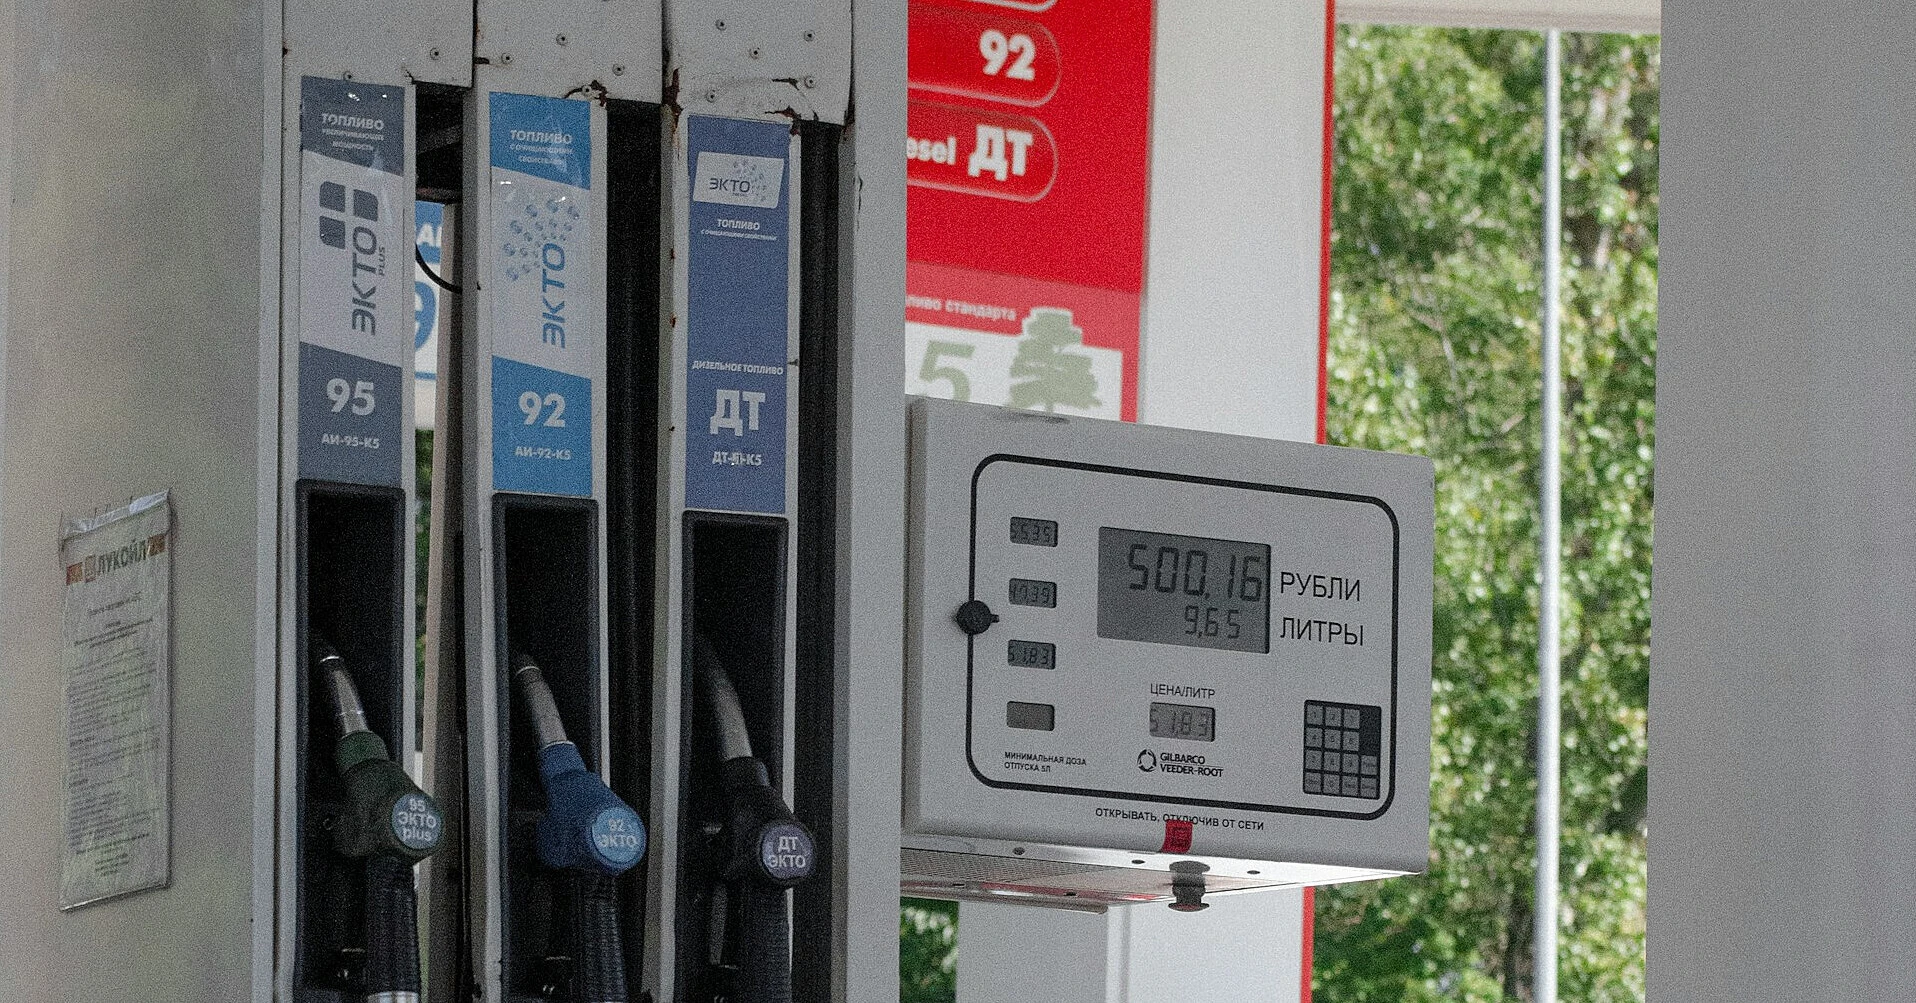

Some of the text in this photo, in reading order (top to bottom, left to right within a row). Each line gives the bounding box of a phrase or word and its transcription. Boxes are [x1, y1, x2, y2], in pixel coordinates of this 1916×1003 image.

[979, 29, 1036, 81] 92
[321, 113, 385, 131] ТОПЛИВО
[509, 129, 573, 145] ТОПЛИВО
[968, 124, 1035, 182] ДТ
[709, 177, 751, 193] ЭКТО
[717, 218, 760, 231] ТОПЛИВО
[378, 246, 386, 276] PLUS
[352, 226, 377, 336] ЭКТО
[542, 243, 566, 349] ЭКТО
[945, 299, 1018, 322] стандарта
[692, 360, 783, 376] ДИЗЕЛЬНОЕ ТОПЛИВО
[919, 340, 976, 403] 5
[326, 378, 376, 416] 95
[518, 391, 566, 429] 92
[710, 389, 766, 437] ДТ
[321, 432, 380, 450] АИ-95-К5
[515, 445, 572, 461] АИ-92-К5
[1127, 543, 1262, 602] 500,16
[1280, 571, 1361, 602] РУБЛИ
[1185, 605, 1240, 639] 9,65
[1280, 617, 1364, 646] ЛИТРЫ
[1150, 683, 1216, 700] ЦЕНА/ЛИТР
[1004, 751, 1087, 766] МИНИМАЛЬНАЯ ДОЗА
[1004, 761, 1039, 772] ОТПУСКА
[1160, 752, 1206, 765] GILBARCO
[1160, 764, 1224, 778] VEEDER-ROOT
[409, 798, 426, 813] 95
[398, 811, 437, 828] ЭКТО
[608, 819, 625, 832] 92
[1222, 818, 1236, 829] ОТ
[1238, 820, 1264, 831] СЕТИ
[403, 827, 432, 841] plus
[600, 834, 637, 848] ЭКТО
[778, 836, 798, 853] ДТ
[768, 854, 806, 869] ЭКТО
